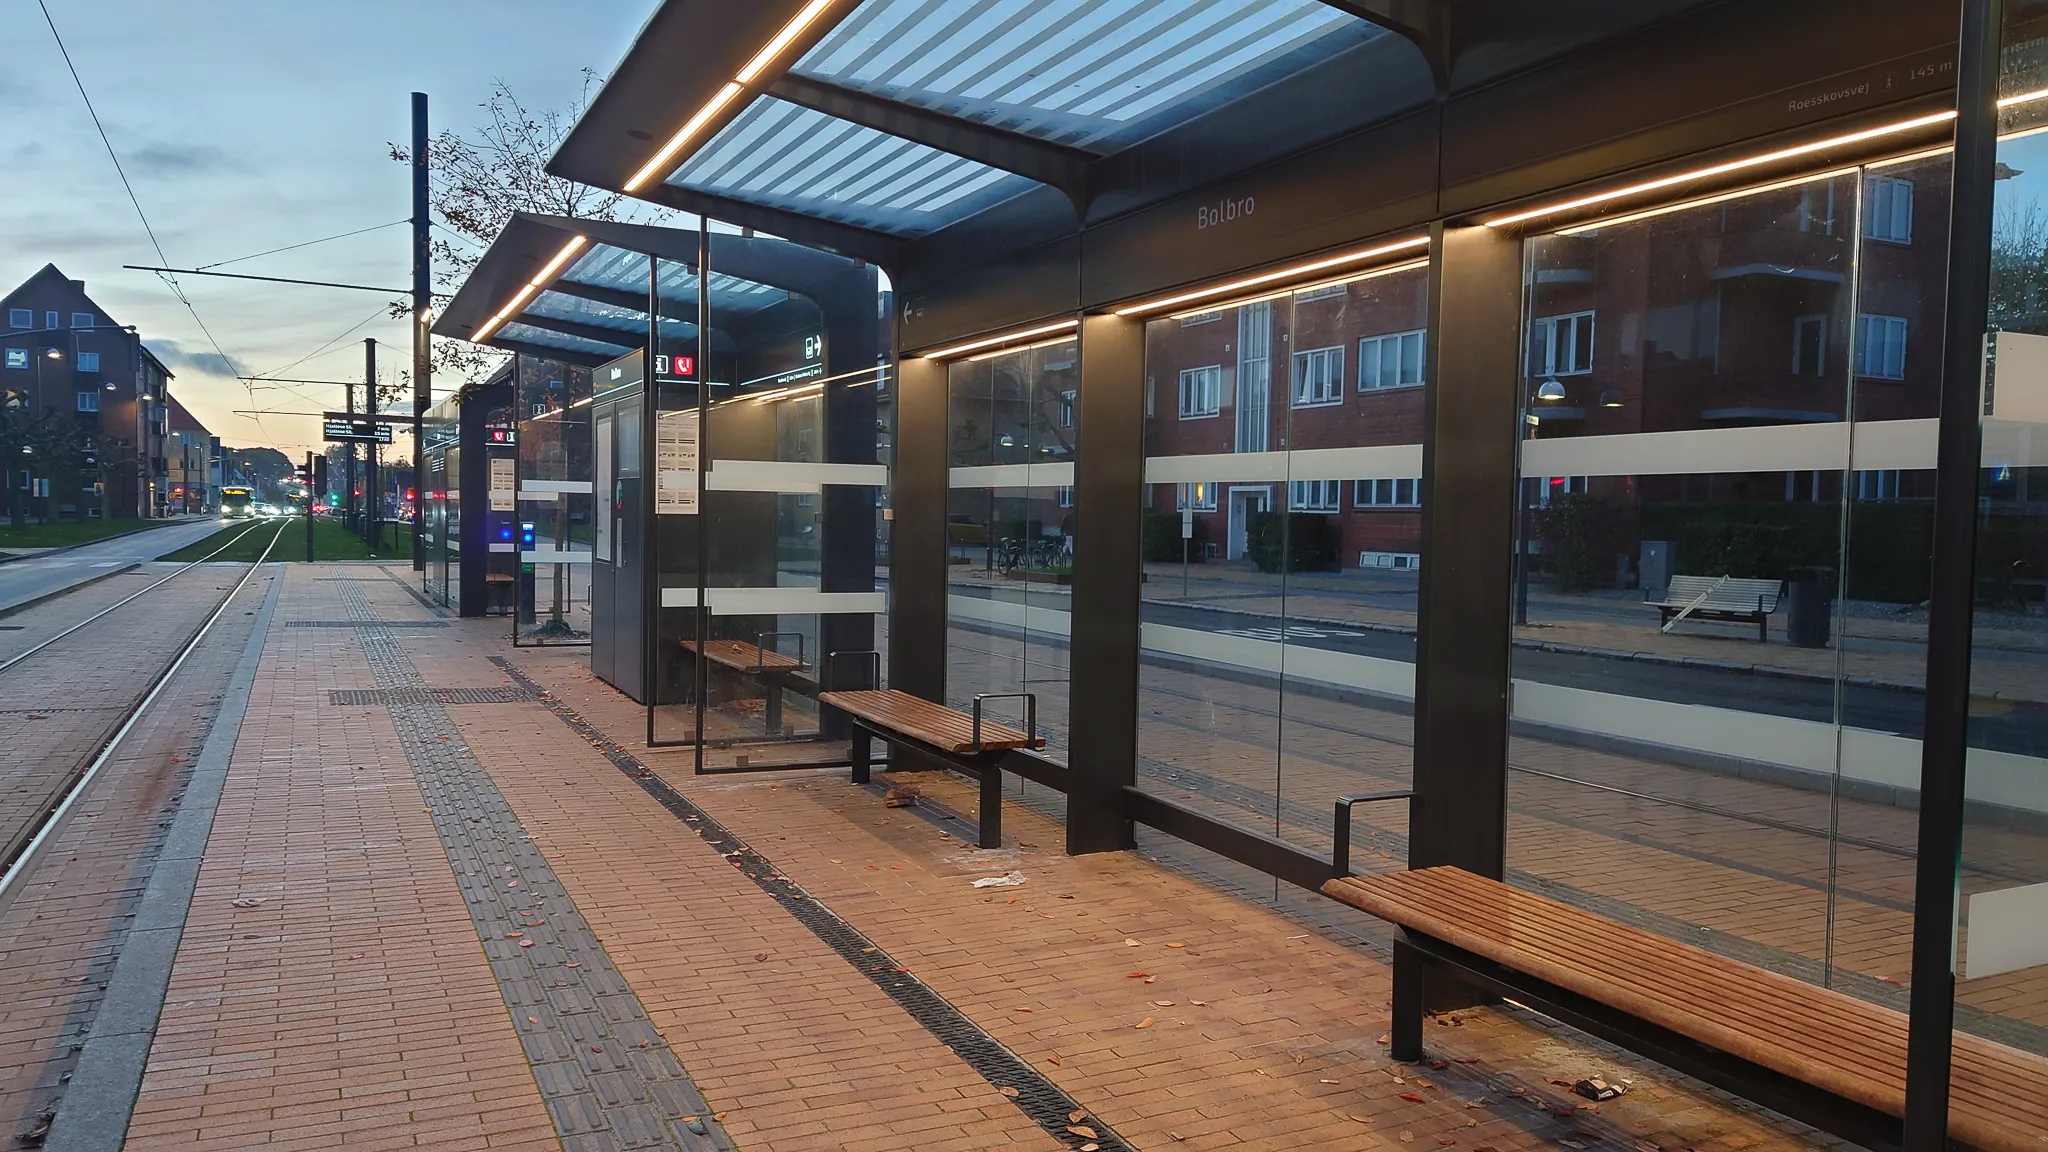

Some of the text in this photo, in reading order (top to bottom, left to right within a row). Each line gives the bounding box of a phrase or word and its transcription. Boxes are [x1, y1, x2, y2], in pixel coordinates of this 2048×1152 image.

[1788, 61, 1953, 111] Roesskovsvej 145 m
[1198, 196, 1255, 230] Bolbro
